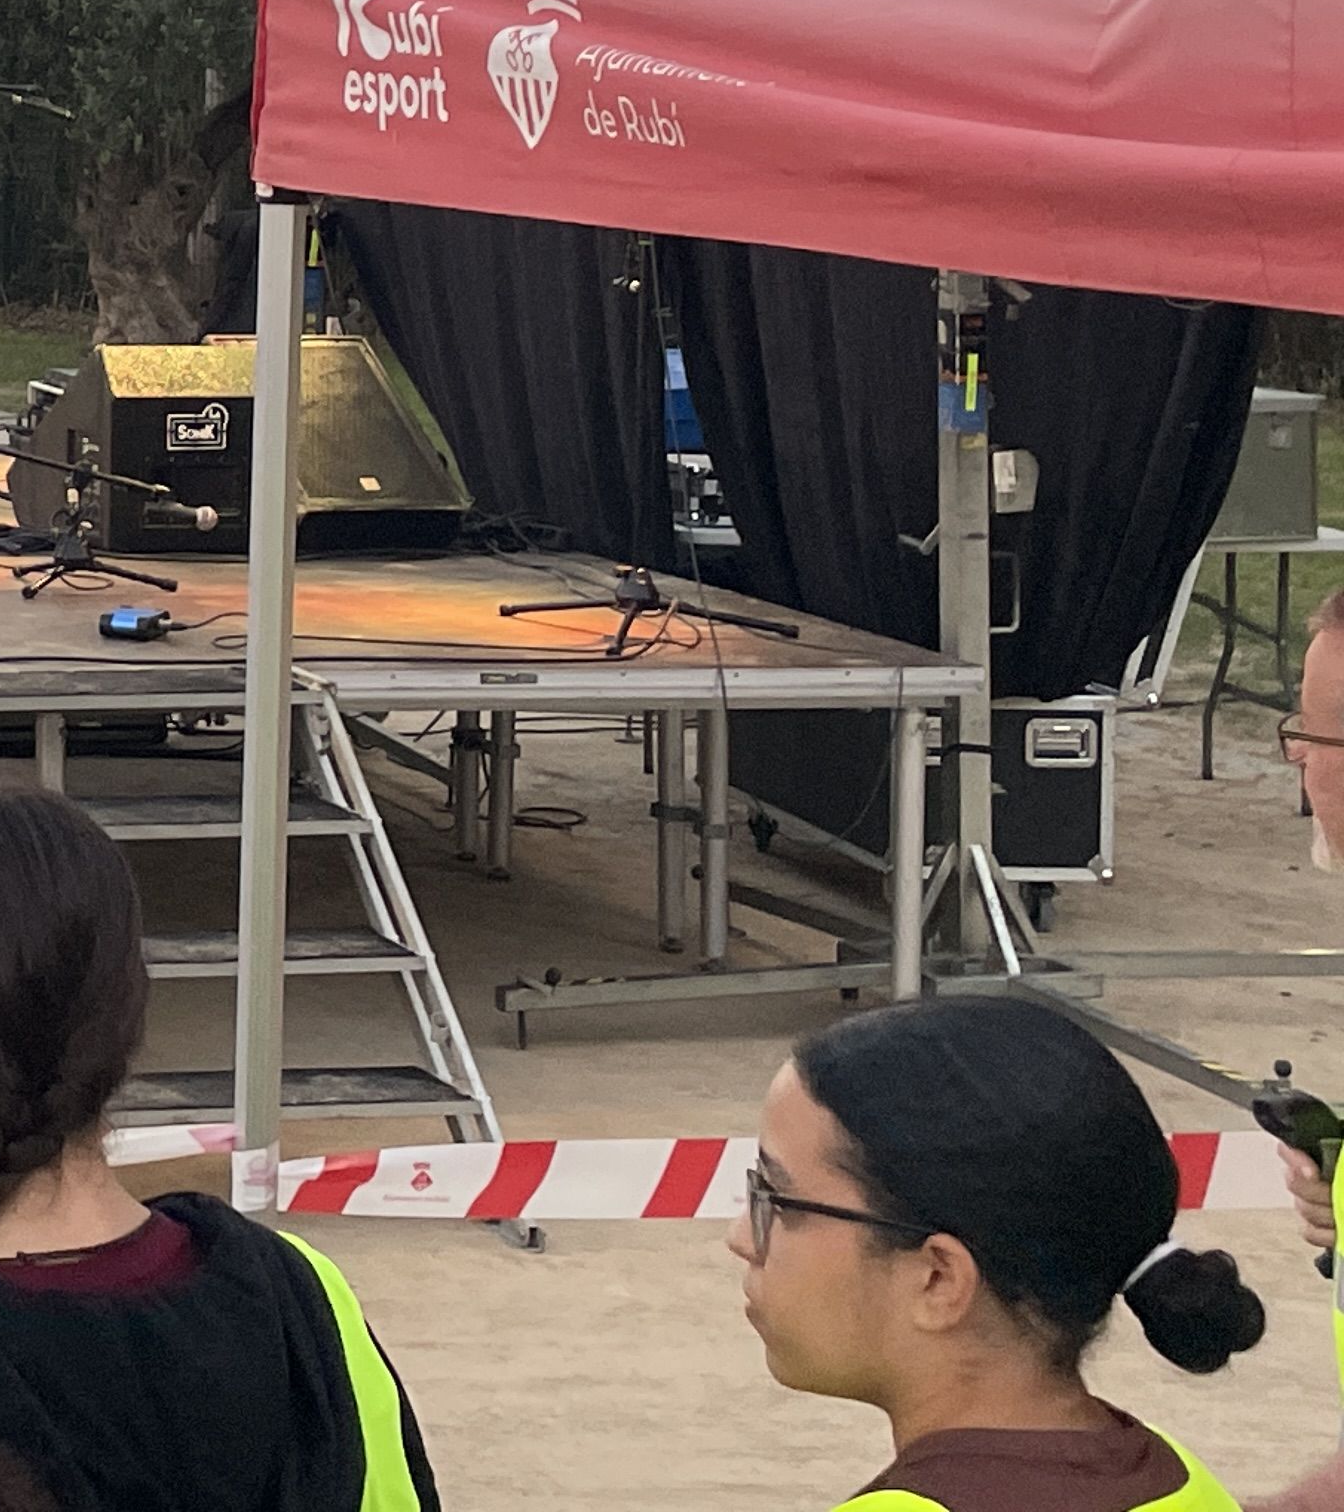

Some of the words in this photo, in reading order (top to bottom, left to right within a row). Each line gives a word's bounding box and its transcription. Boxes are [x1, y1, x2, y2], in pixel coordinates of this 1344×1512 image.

[344, 67, 450, 131] esport
[583, 89, 618, 138] de
[618, 96, 686, 148] Rubí
